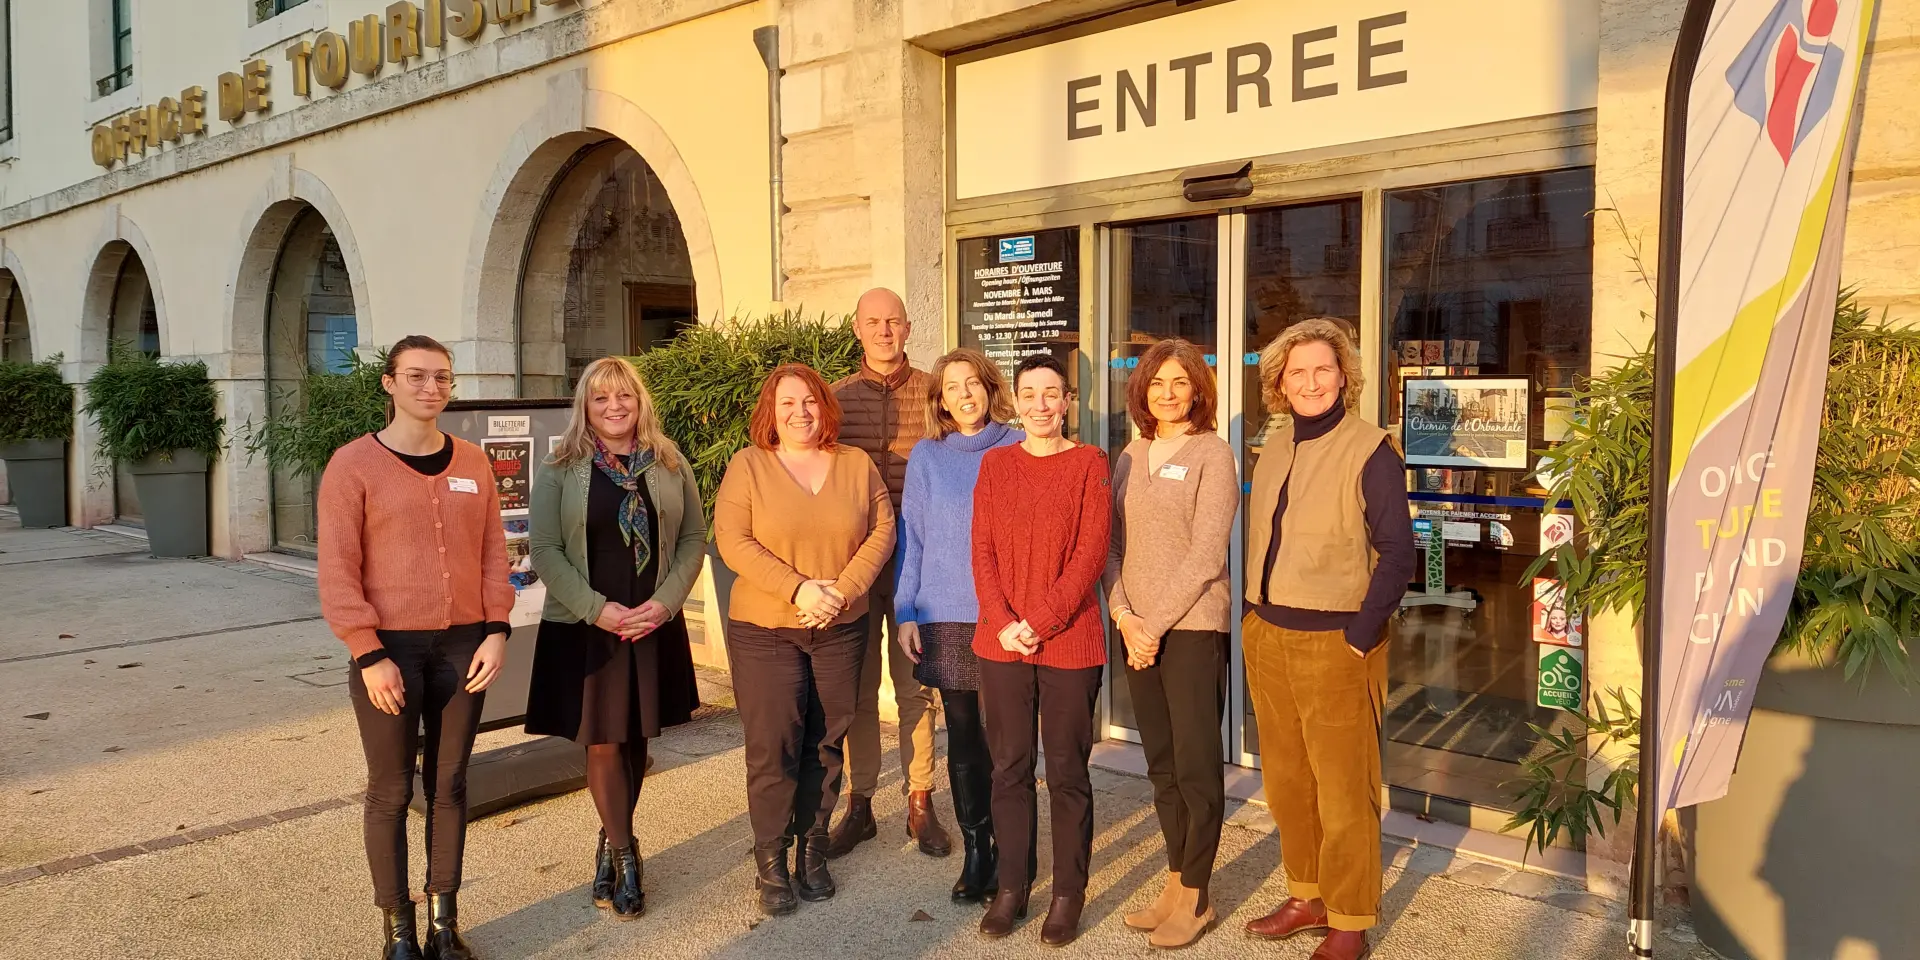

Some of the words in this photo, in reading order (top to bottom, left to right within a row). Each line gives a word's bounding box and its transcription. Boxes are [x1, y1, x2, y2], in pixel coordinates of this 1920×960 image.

[1067, 10, 1407, 141] ENTREE
[91, 85, 203, 166] OFFICE
[218, 59, 268, 121] DE
[285, 0, 573, 96] TOURIS
[974, 266, 1009, 277] HORAIRES
[1011, 261, 1063, 274] D'OUVERTURE
[981, 278, 1002, 287] Opening
[1003, 276, 1017, 285] hours
[983, 288, 1021, 299] NOVEMBRE
[1024, 286, 1029, 296] À
[1032, 286, 1053, 296] MARS
[983, 312, 993, 321] Du
[994, 310, 1015, 321] Mardi
[1026, 308, 1053, 318] Samedi
[978, 332, 991, 340] 9.30
[995, 331, 1012, 340] 12.30
[1020, 330, 1037, 339] 14.00
[1041, 329, 1060, 338] 17.30
[985, 349, 1020, 358] Fermeture
[1410, 416, 1449, 431] Chemin
[1451, 420, 1462, 431] de
[1464, 417, 1523, 433] l'Orbandale
[496, 449, 518, 461] ROCK
[1542, 690, 1574, 699] ACCUEIL
